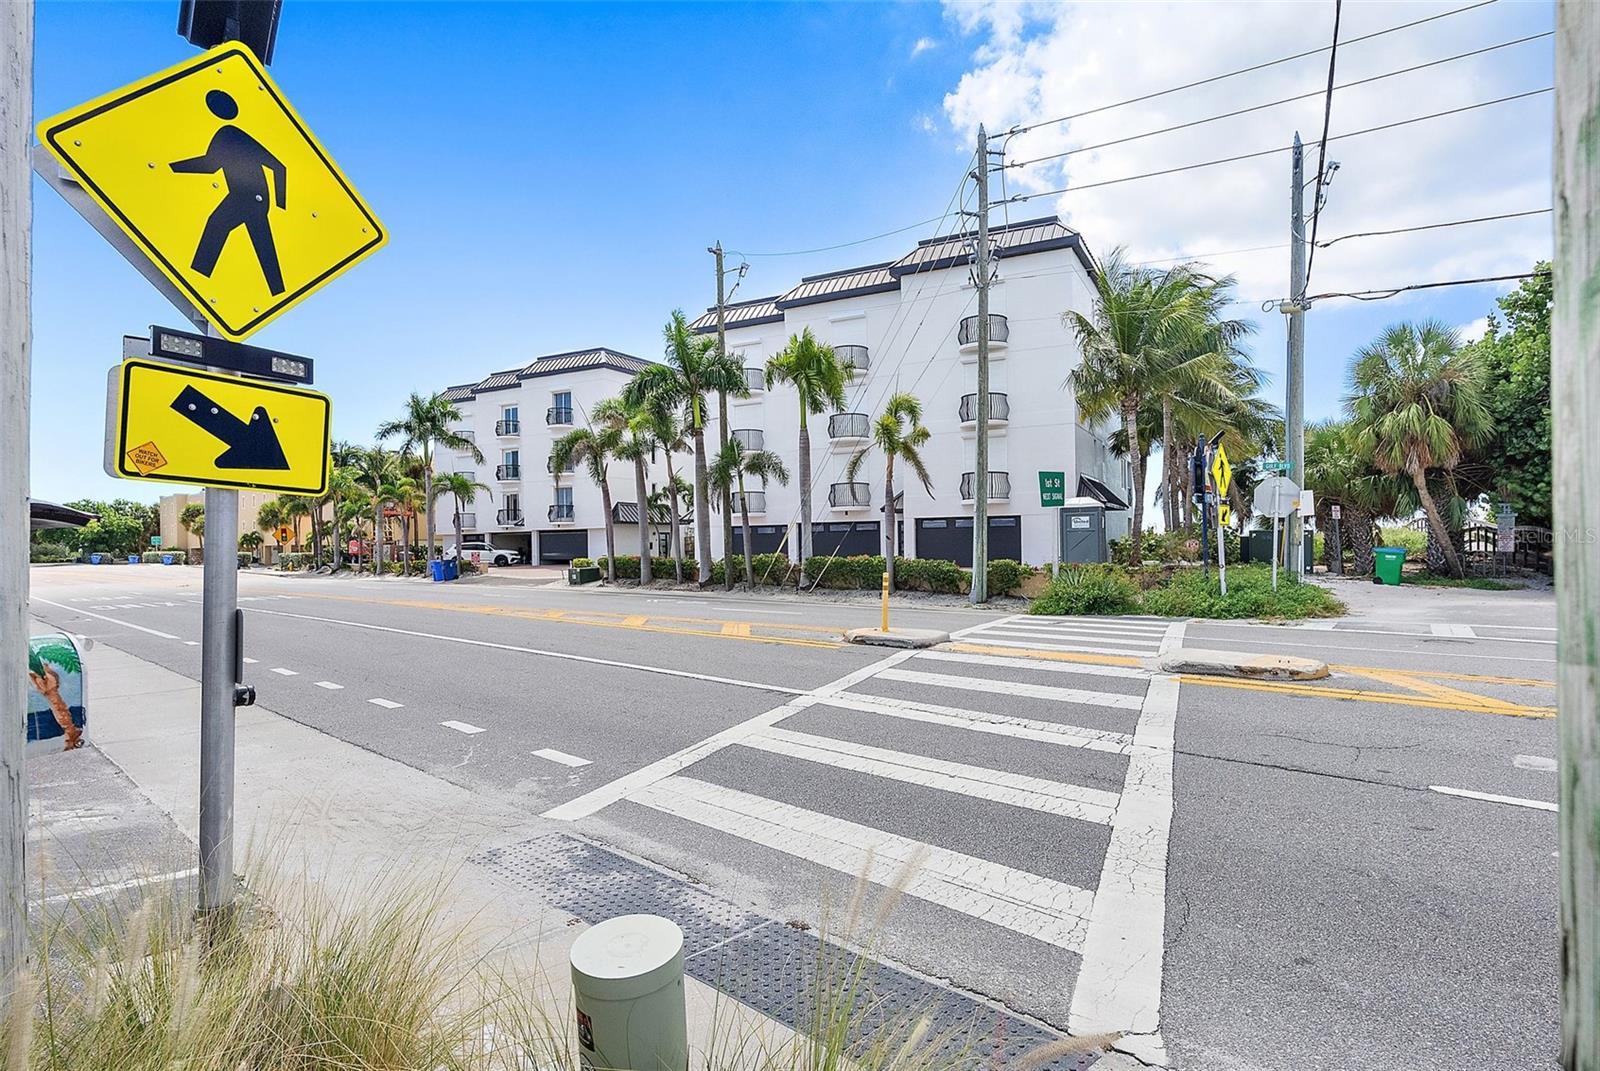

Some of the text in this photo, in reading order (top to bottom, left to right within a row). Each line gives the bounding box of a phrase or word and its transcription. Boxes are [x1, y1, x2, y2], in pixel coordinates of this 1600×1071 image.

[138, 449, 158, 457] WATCH
[135, 458, 156, 467] BIKERS
[1044, 478, 1061, 488] 1st St
[1042, 492, 1063, 501] NEXT SIGNAL
